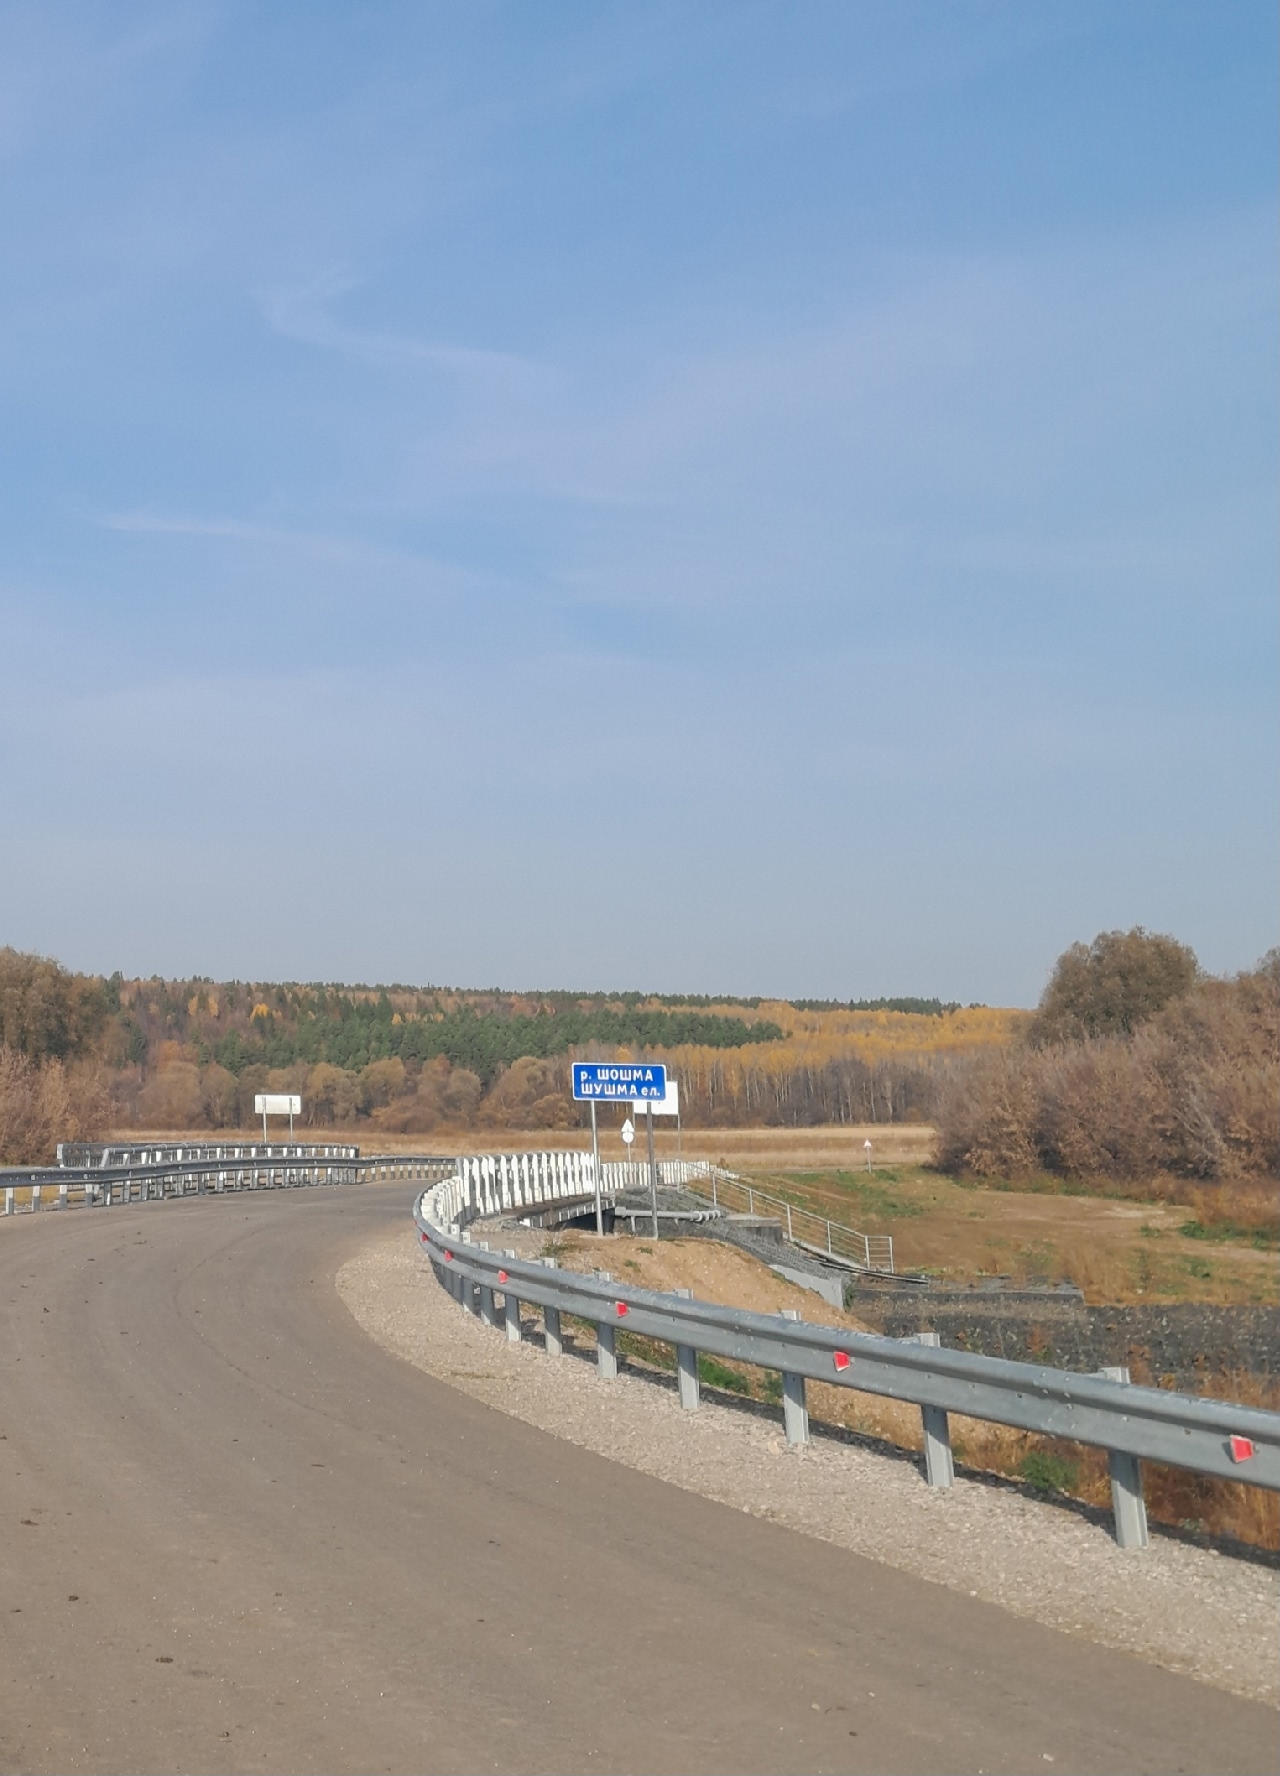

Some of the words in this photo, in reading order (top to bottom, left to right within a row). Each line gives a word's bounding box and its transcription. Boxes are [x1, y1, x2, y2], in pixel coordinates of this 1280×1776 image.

[580, 1071, 592, 1082] р.
[597, 1069, 653, 1082] ШОШМА
[581, 1083, 638, 1096] ШУШМА
[641, 1087, 660, 1096] ел.
